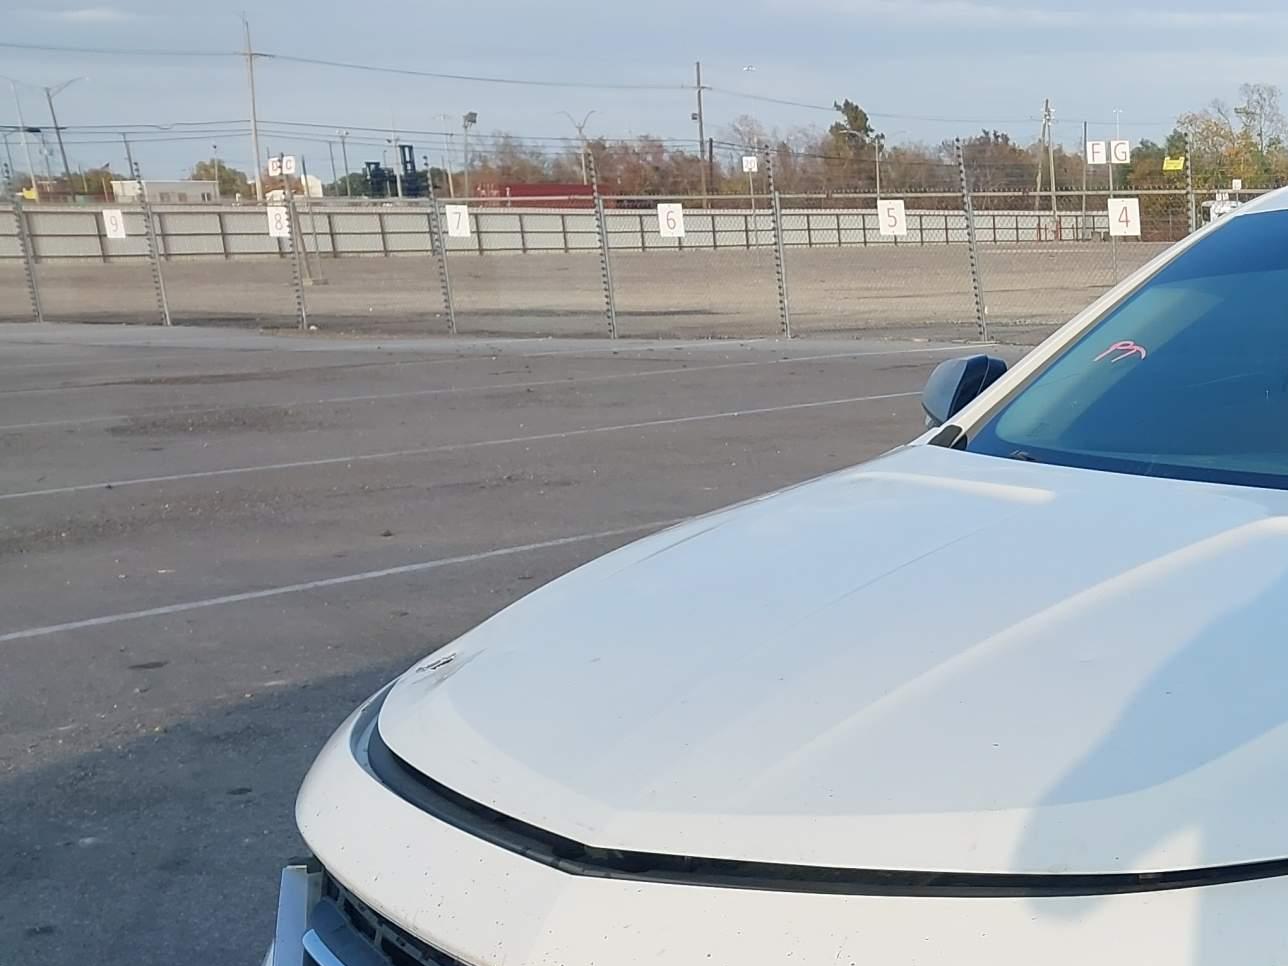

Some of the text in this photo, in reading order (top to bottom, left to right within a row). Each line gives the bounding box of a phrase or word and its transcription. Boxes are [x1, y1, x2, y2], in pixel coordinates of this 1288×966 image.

[1092, 142, 1100, 162] F
[1113, 142, 1127, 162] G
[110, 215, 119, 233] 9
[274, 212, 284, 231] 8
[453, 211, 462, 230] 7
[666, 210, 677, 230] 6
[887, 207, 898, 228] 5
[1118, 205, 1131, 228] 4
